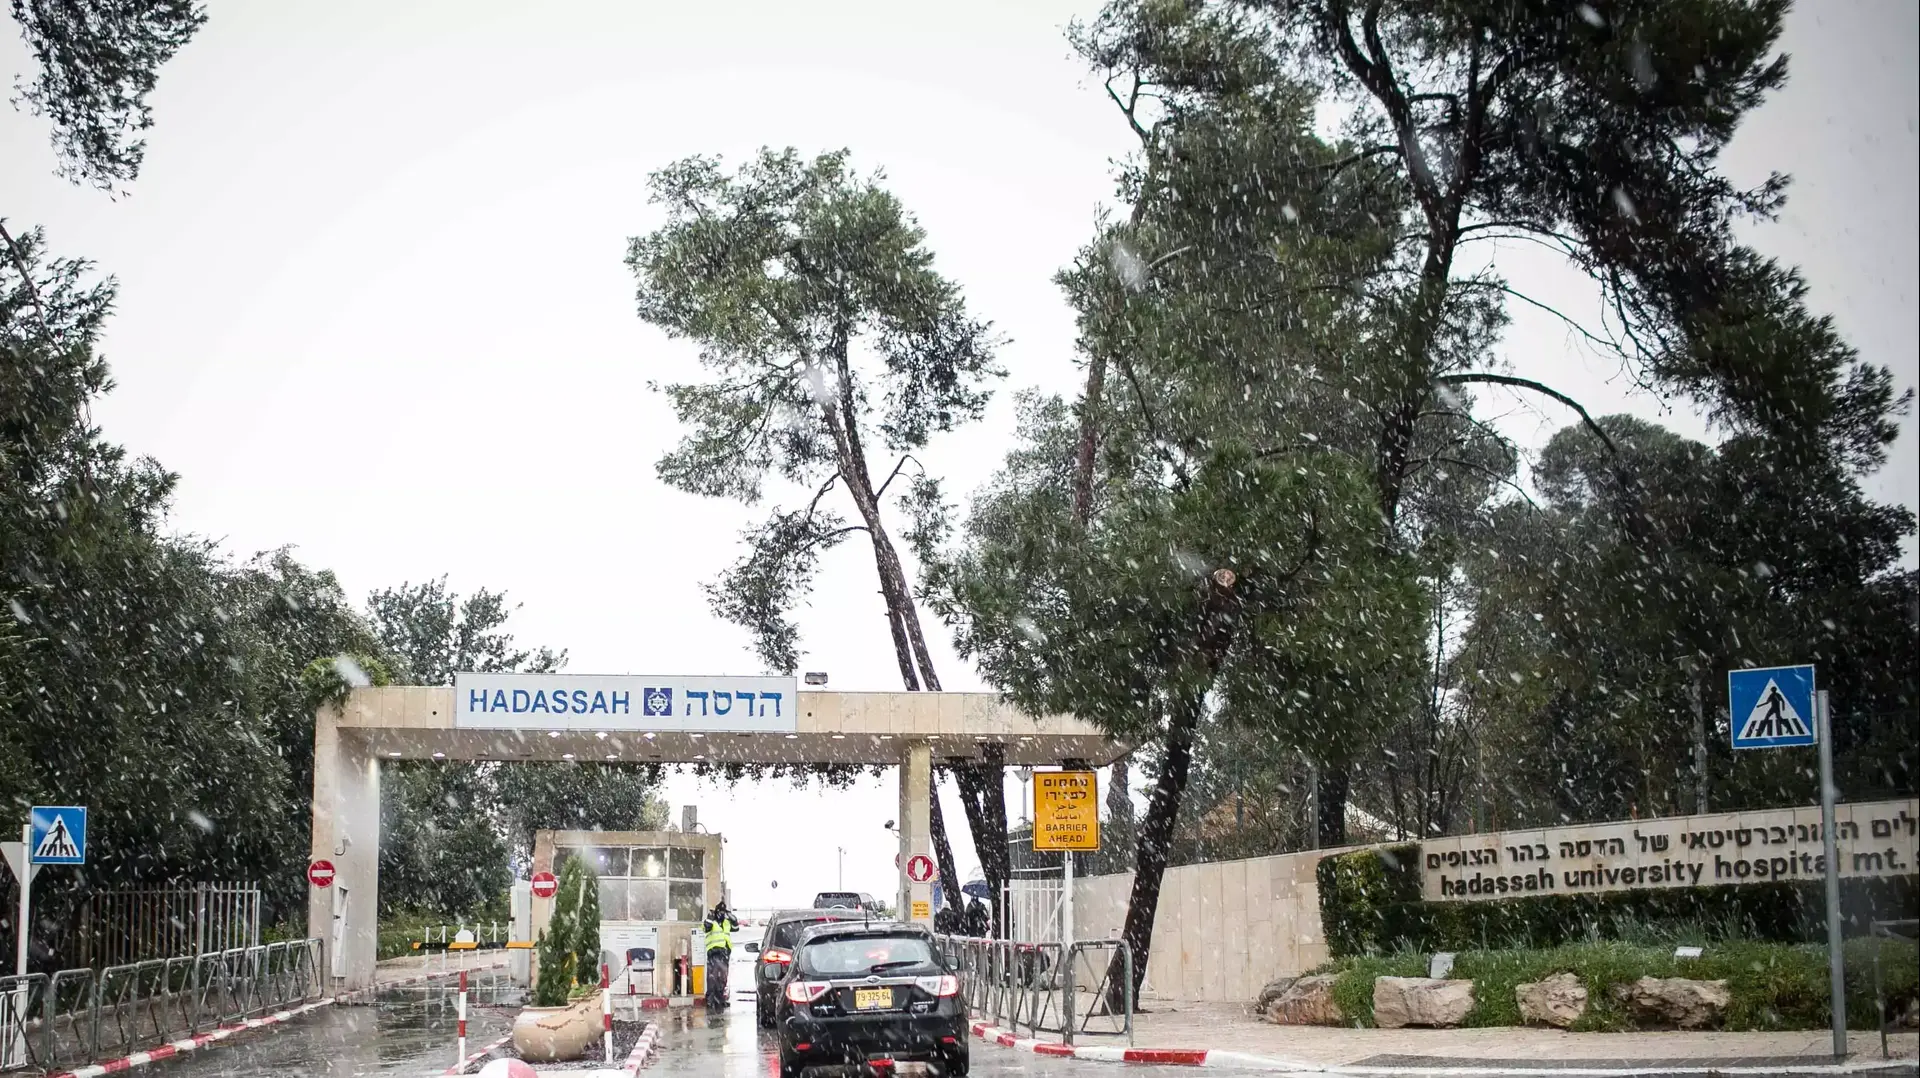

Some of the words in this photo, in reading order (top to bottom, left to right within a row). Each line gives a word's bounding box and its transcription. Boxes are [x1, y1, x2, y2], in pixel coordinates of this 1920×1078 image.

[470, 689, 629, 714] HADASSAH
[686, 690, 783, 717] הדסה
[1044, 779, 1088, 787] מחסום
[1871, 811, 1919, 838] לים
[1048, 835, 1086, 843] AHEAD!
[1560, 837, 1625, 859] הדסה
[1633, 829, 1669, 853] של
[1426, 848, 1498, 869] הצופים
[1505, 843, 1550, 862] בהר
[1441, 867, 1554, 896] hadassah
[1564, 858, 1704, 887] university
[1714, 848, 1841, 881] hospital
[1854, 847, 1906, 872] mt.
